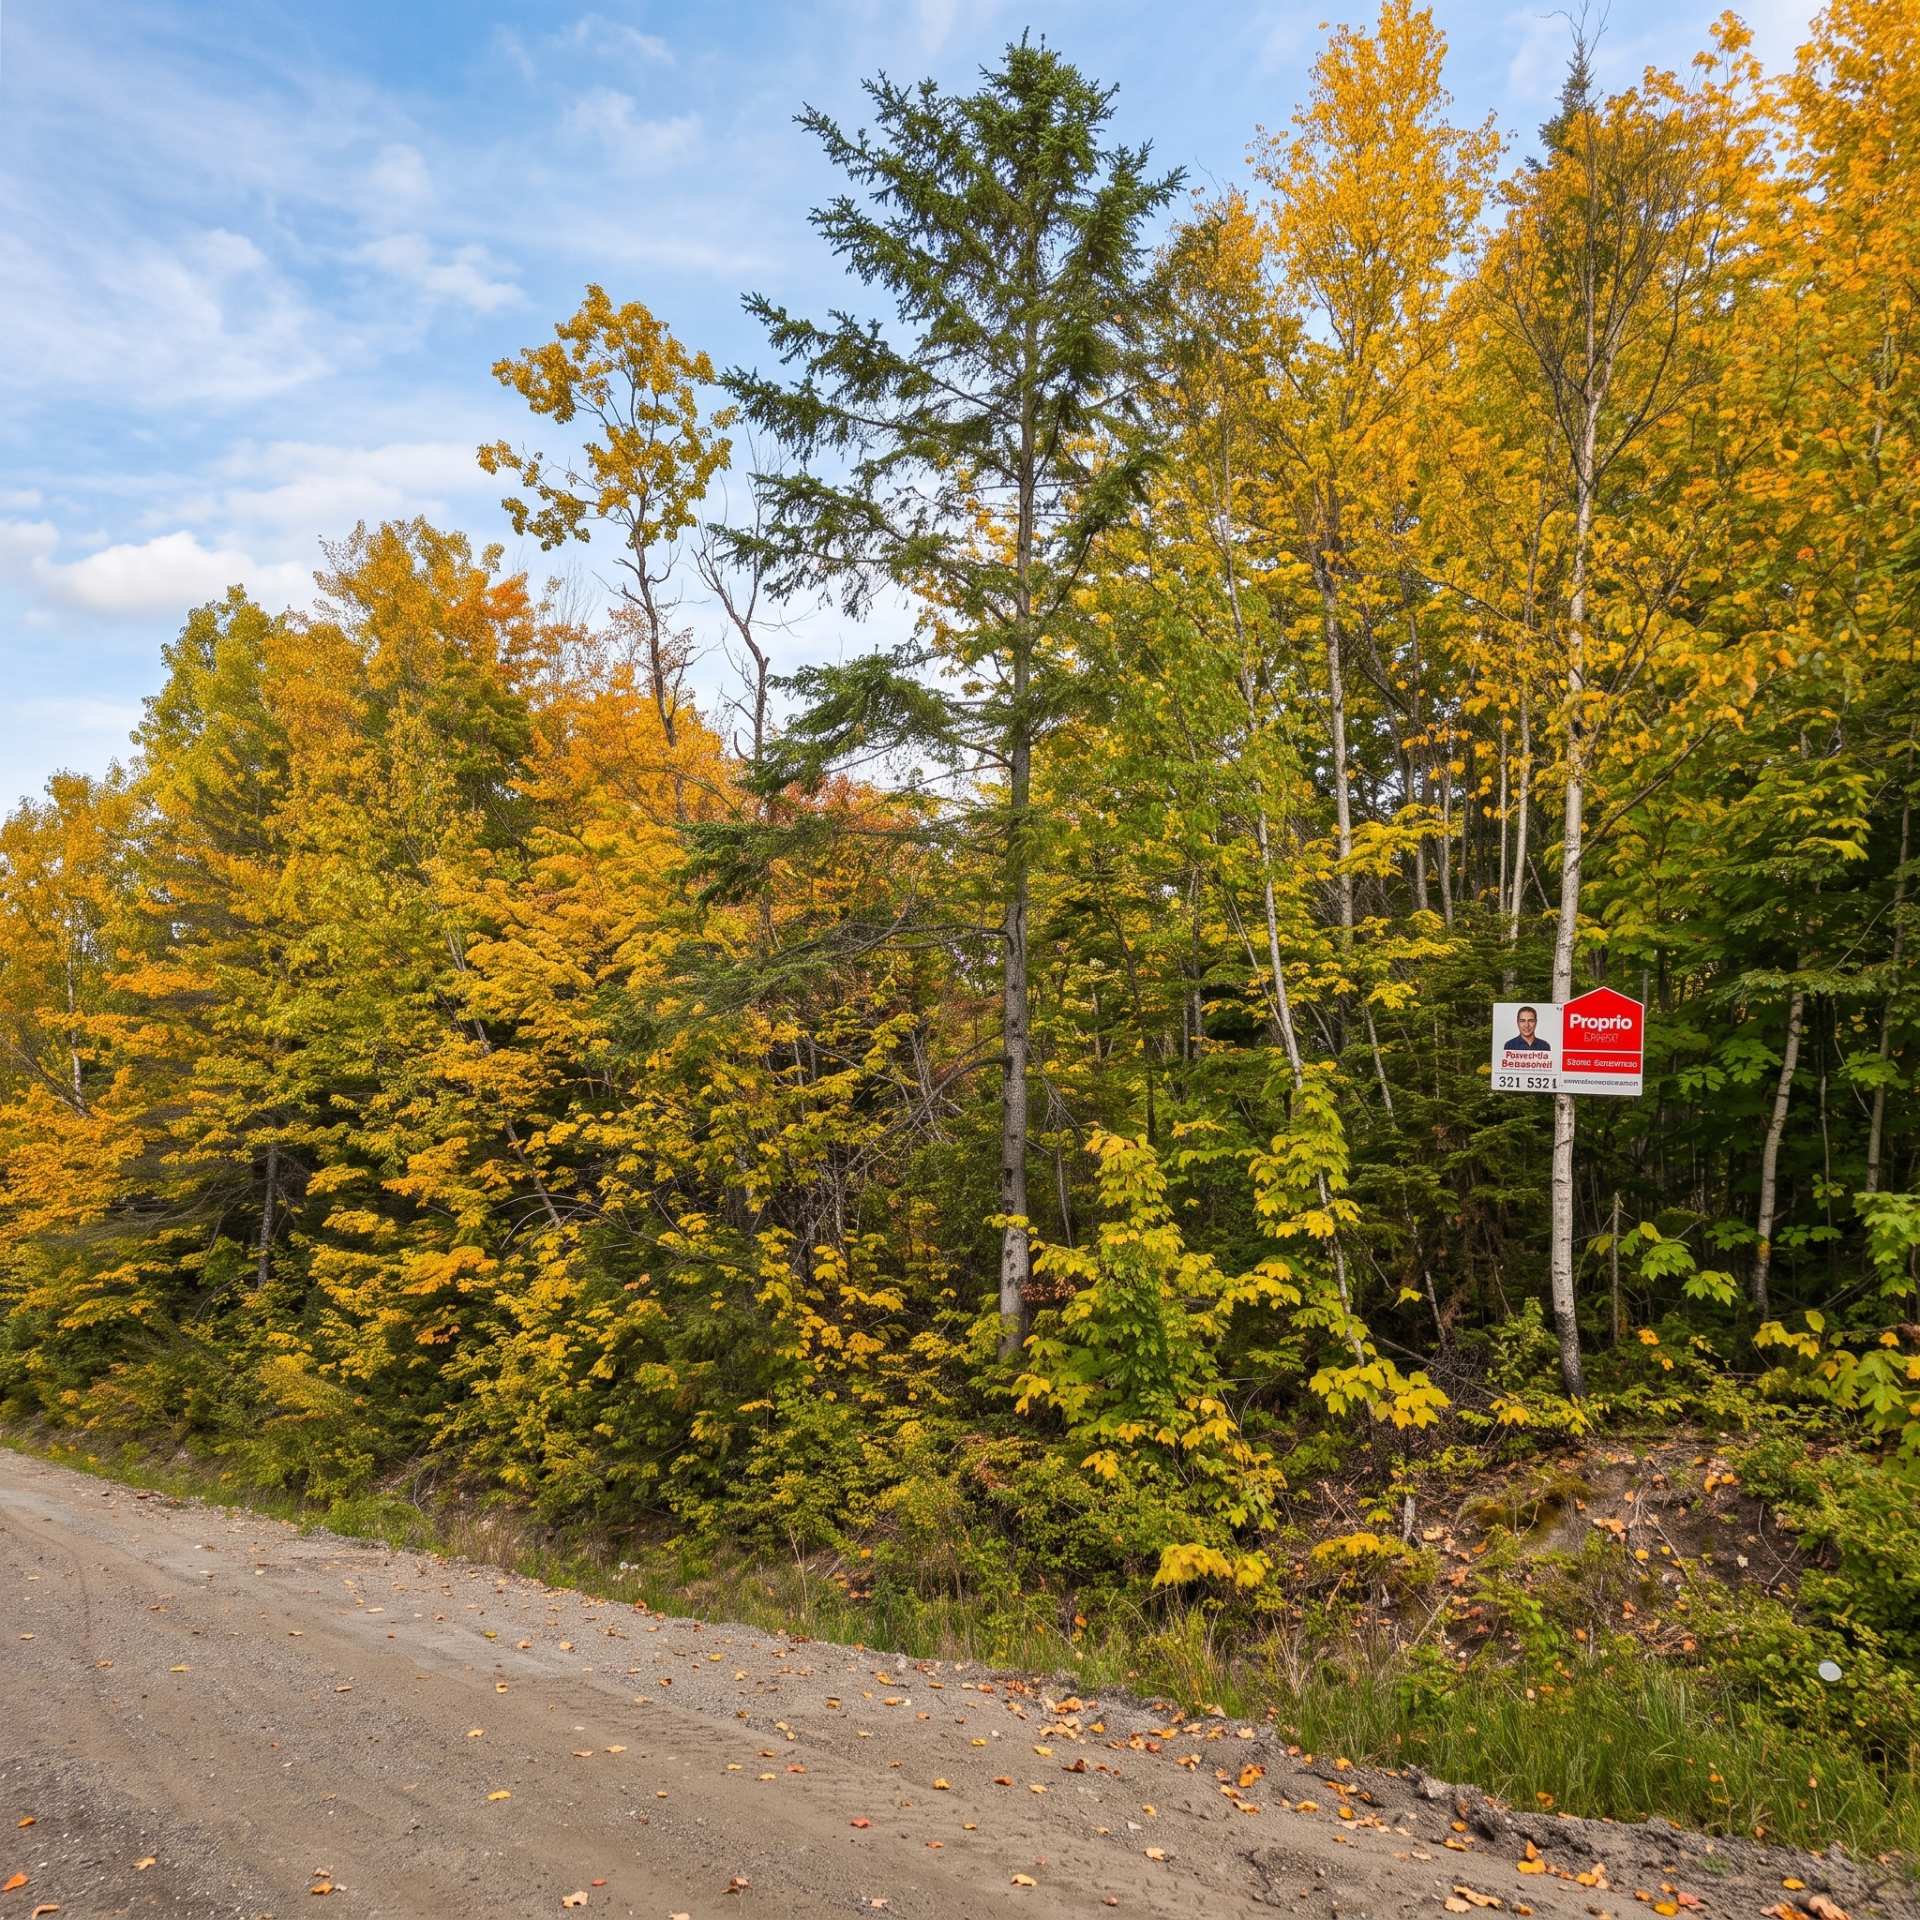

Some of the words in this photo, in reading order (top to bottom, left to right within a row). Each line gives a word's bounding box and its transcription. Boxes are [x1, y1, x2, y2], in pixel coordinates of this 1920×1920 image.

[1570, 1013, 1633, 1032] Proprio
[1499, 1076, 1520, 1088] 321
[1527, 1077, 1557, 1089] 5321
